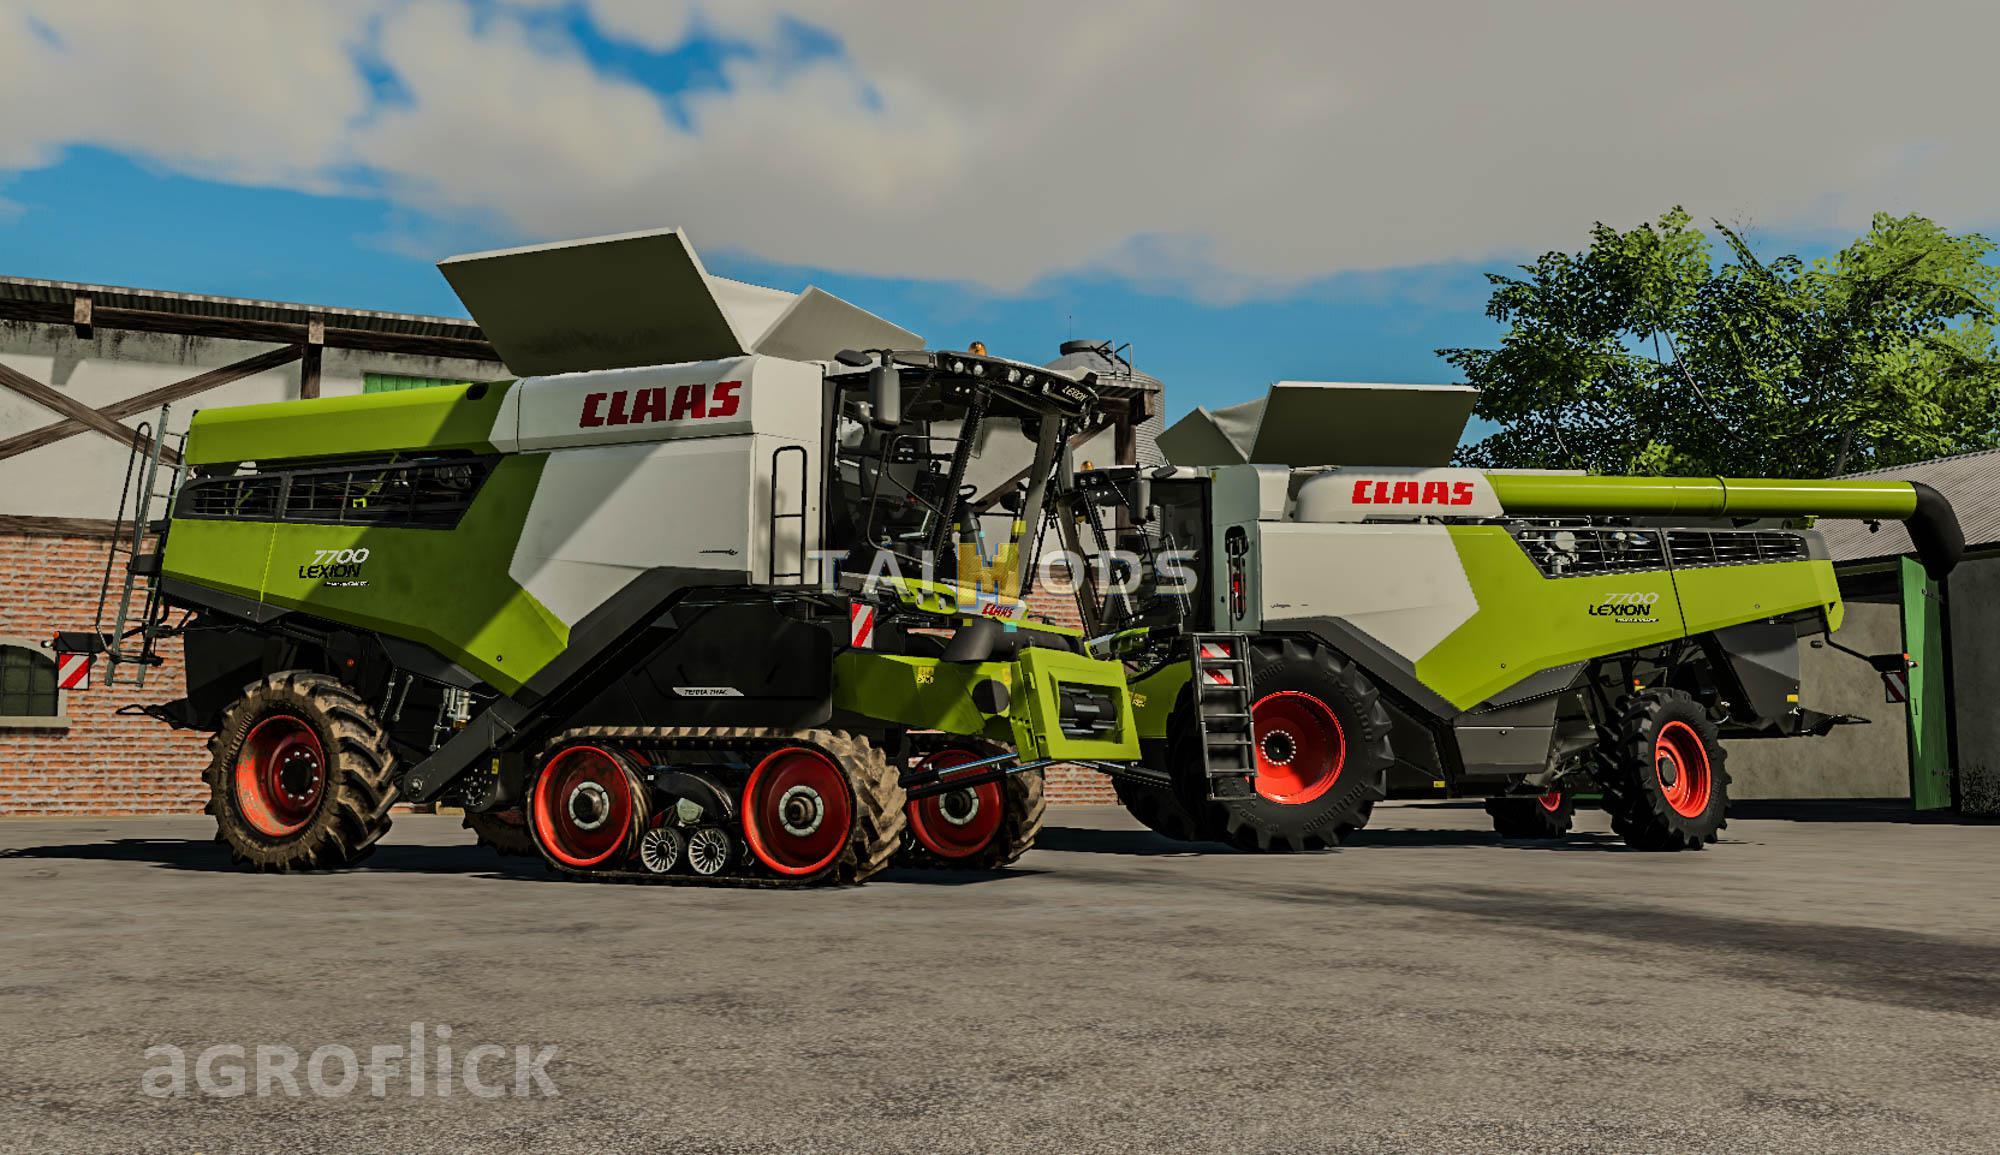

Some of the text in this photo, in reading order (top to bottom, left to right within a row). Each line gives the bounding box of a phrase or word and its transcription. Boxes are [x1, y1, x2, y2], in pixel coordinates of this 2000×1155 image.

[579, 380, 742, 428] CLAAS
[1352, 480, 1474, 505] CLAAS
[312, 548, 370, 565] 7700
[299, 563, 362, 579] LEXION
[1604, 592, 1659, 605] 7700
[1588, 604, 1651, 616] LEXION
